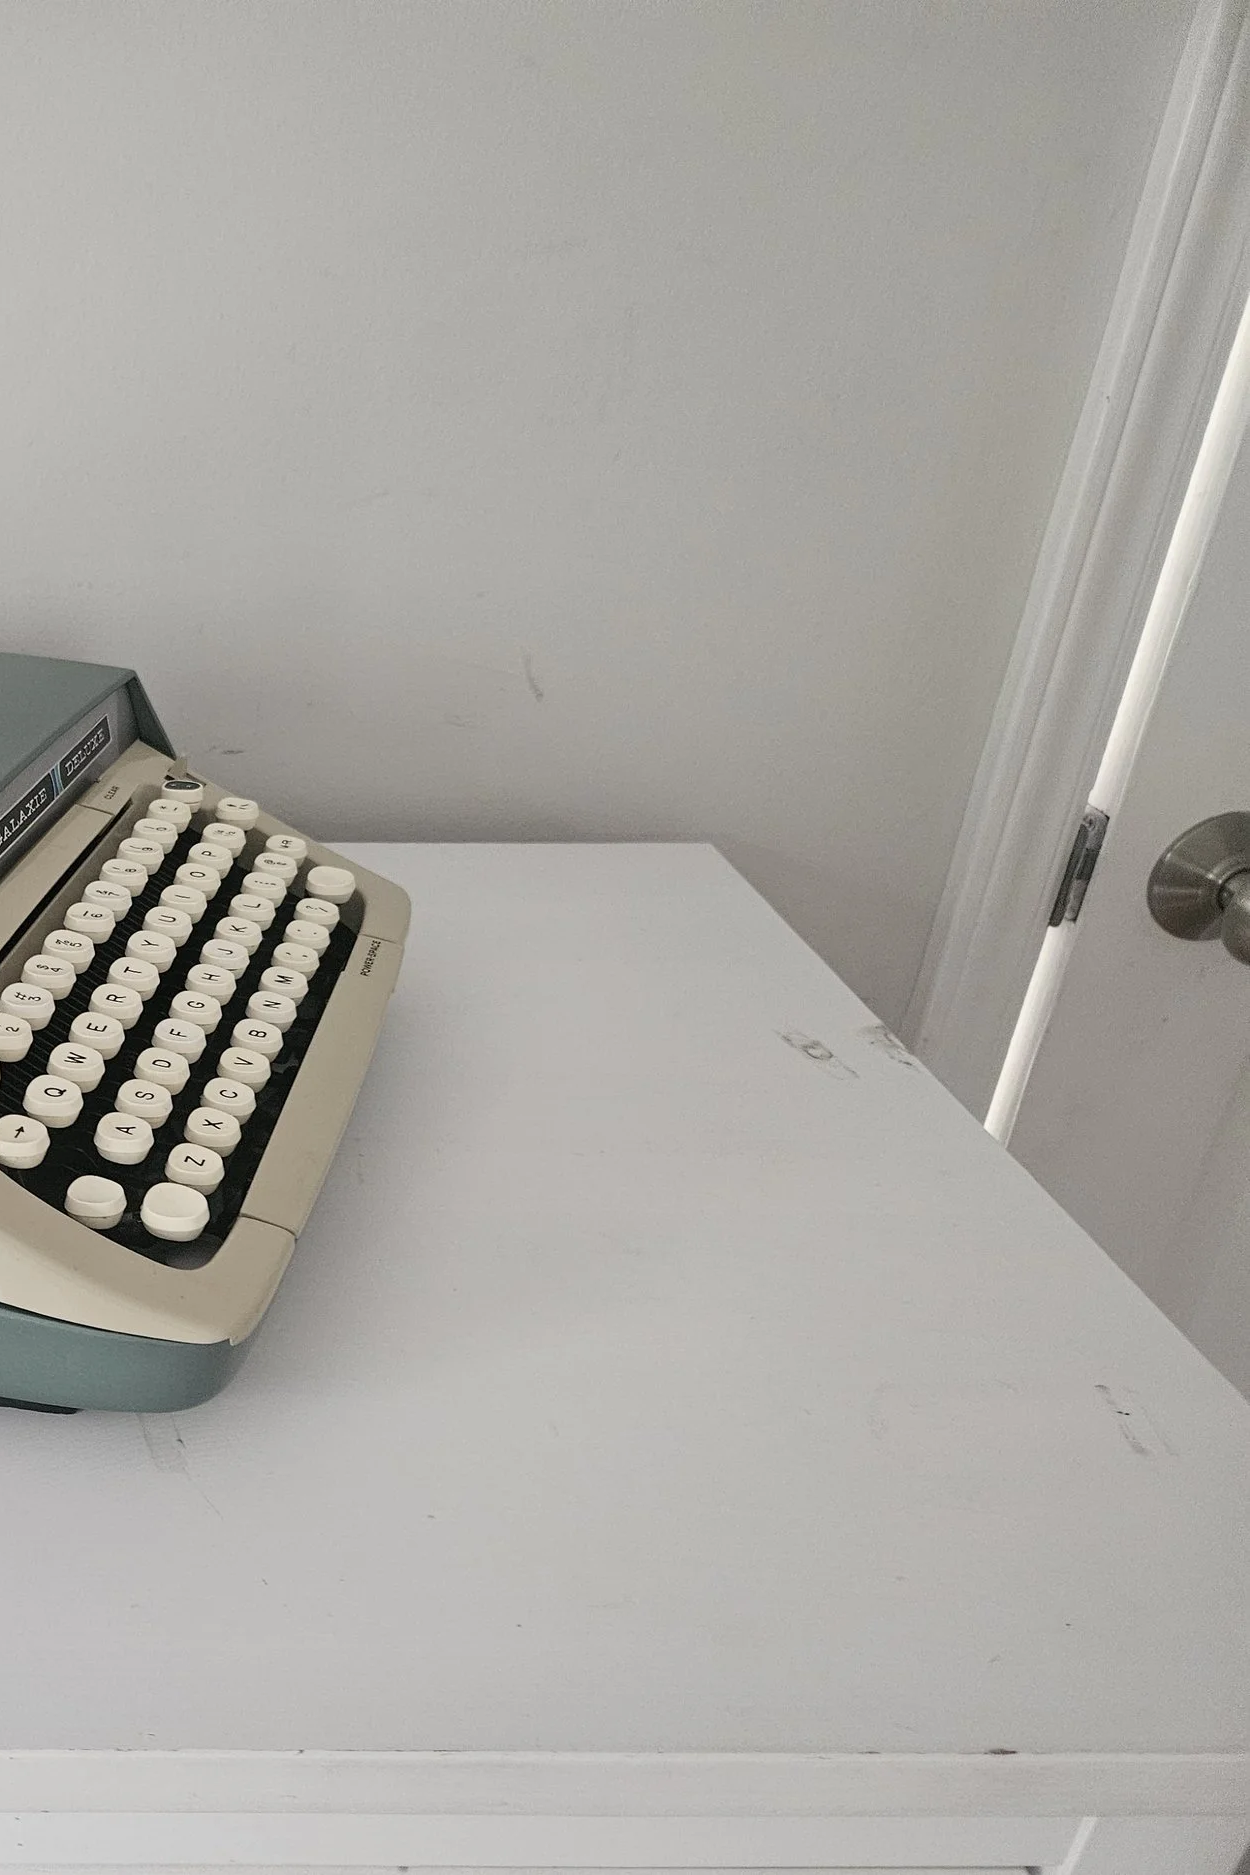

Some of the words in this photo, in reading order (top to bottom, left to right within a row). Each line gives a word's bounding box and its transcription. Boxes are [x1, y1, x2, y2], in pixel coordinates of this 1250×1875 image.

[65, 728, 105, 776] DELUXE
[104, 785, 119, 800] CLEAR
[159, 915, 176, 923] U
[230, 925, 246, 933] K
[202, 973, 220, 982] H
[275, 975, 293, 985] M
[106, 994, 126, 1003] R
[187, 1001, 205, 1009] G
[263, 1001, 281, 1009] N
[87, 1023, 107, 1033] E
[170, 1029, 186, 1038] F
[249, 1030, 267, 1038] B
[64, 1052, 86, 1064] W
[234, 1057, 253, 1066] V
[152, 1060, 171, 1069] D
[44, 1088, 66, 1098] Q
[135, 1091, 154, 1101] S
[220, 1090, 237, 1099] C
[203, 1119, 223, 1130] X
[116, 1127, 136, 1136] A
[184, 1156, 205, 1167] Z
